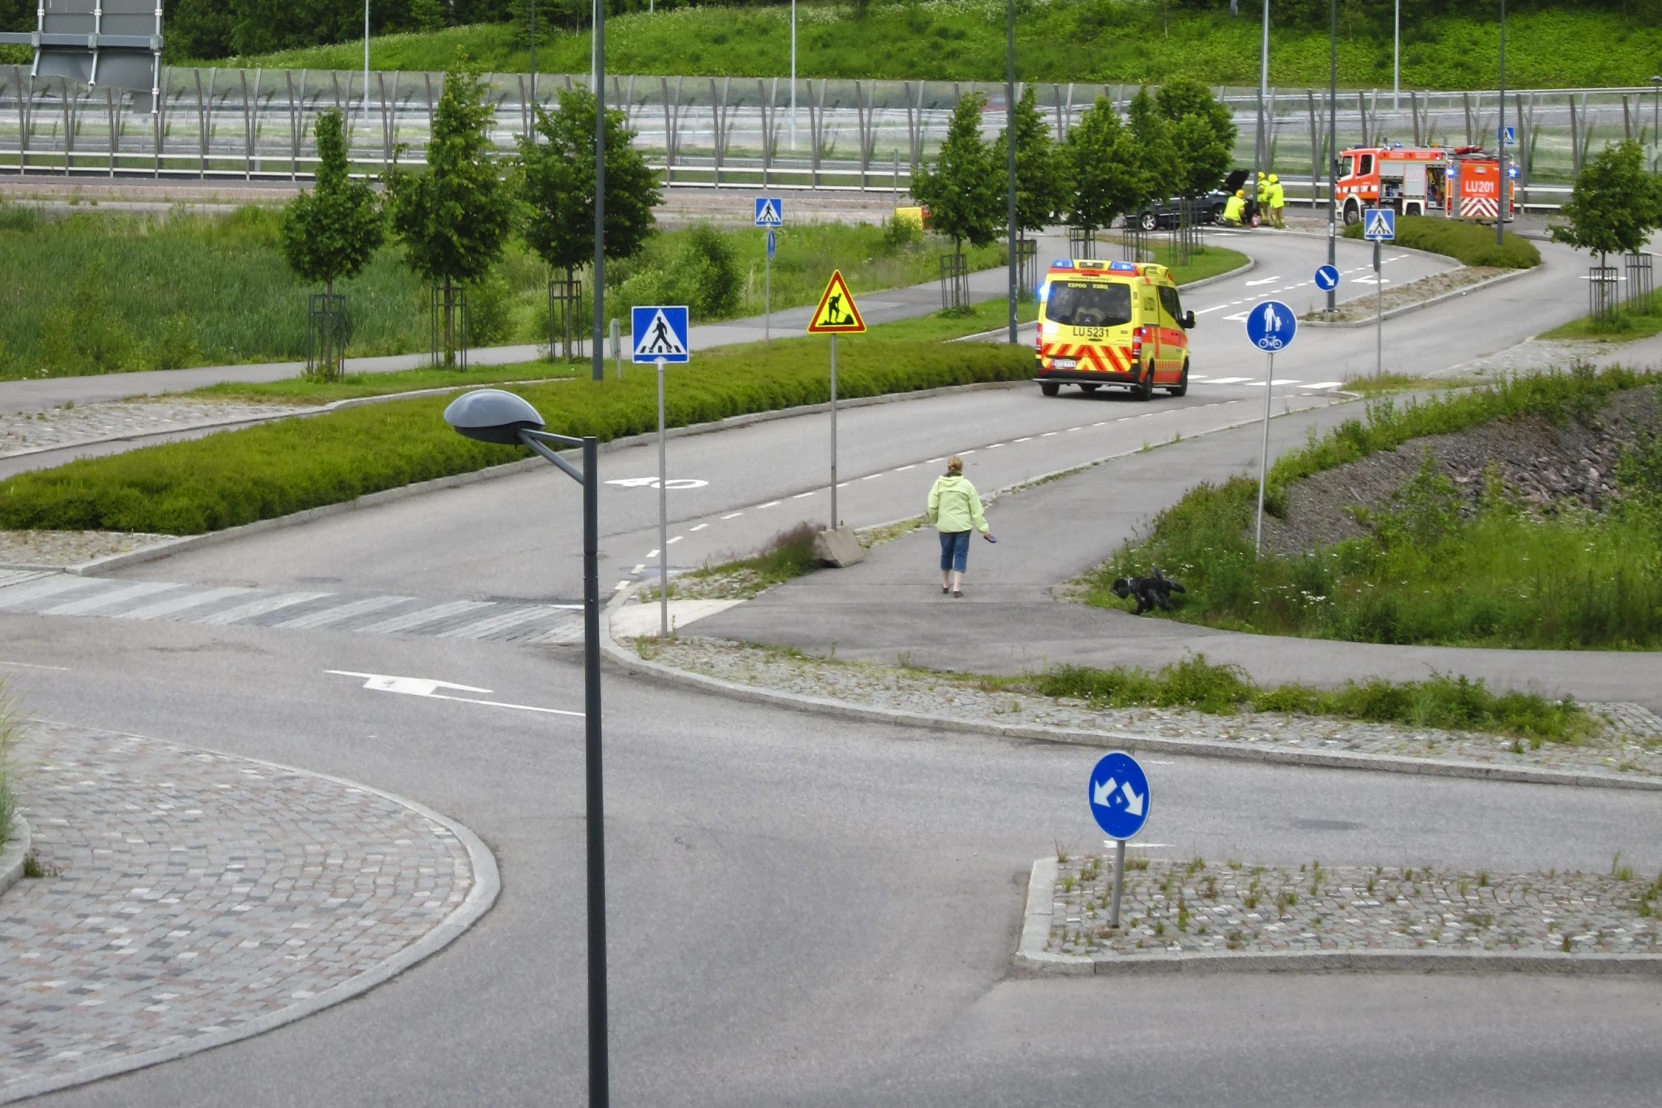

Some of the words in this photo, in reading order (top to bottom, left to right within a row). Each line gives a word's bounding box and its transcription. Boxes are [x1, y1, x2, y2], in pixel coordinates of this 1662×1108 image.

[1465, 181, 1494, 193] LU201
[1073, 327, 1085, 337] LU
[1087, 327, 1109, 337] 5231
